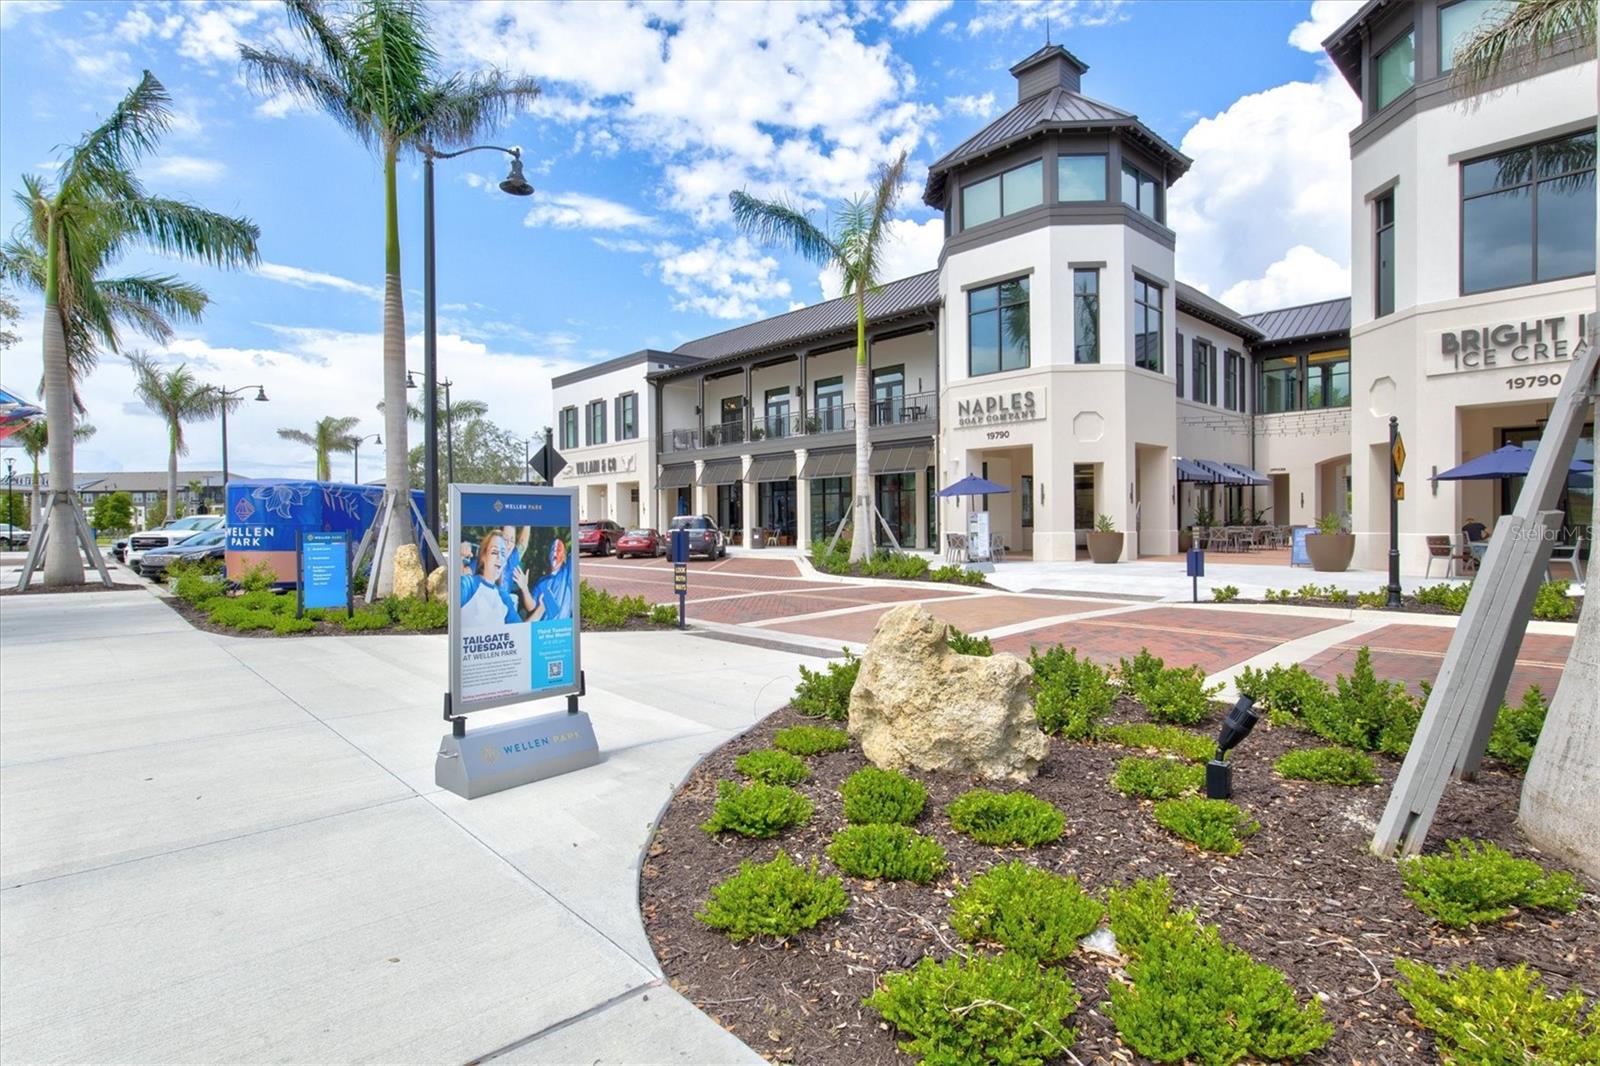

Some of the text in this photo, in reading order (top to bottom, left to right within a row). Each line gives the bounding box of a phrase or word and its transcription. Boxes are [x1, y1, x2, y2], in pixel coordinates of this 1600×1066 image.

[1441, 316, 1565, 354] BRIGHT
[1454, 338, 1588, 369] ICE CREA
[1506, 373, 1562, 390] 19790
[958, 391, 1035, 417] NAPLES
[959, 409, 1036, 426] SOAP COMPANY
[986, 430, 1010, 440] 19790
[231, 537, 260, 547] PARK
[463, 632, 510, 645] TAILGATE
[463, 640, 515, 654] TUESDAYS
[473, 651, 500, 660] WELLEN
[501, 649, 517, 657] PARK
[503, 730, 581, 754] WELLEN PARK
